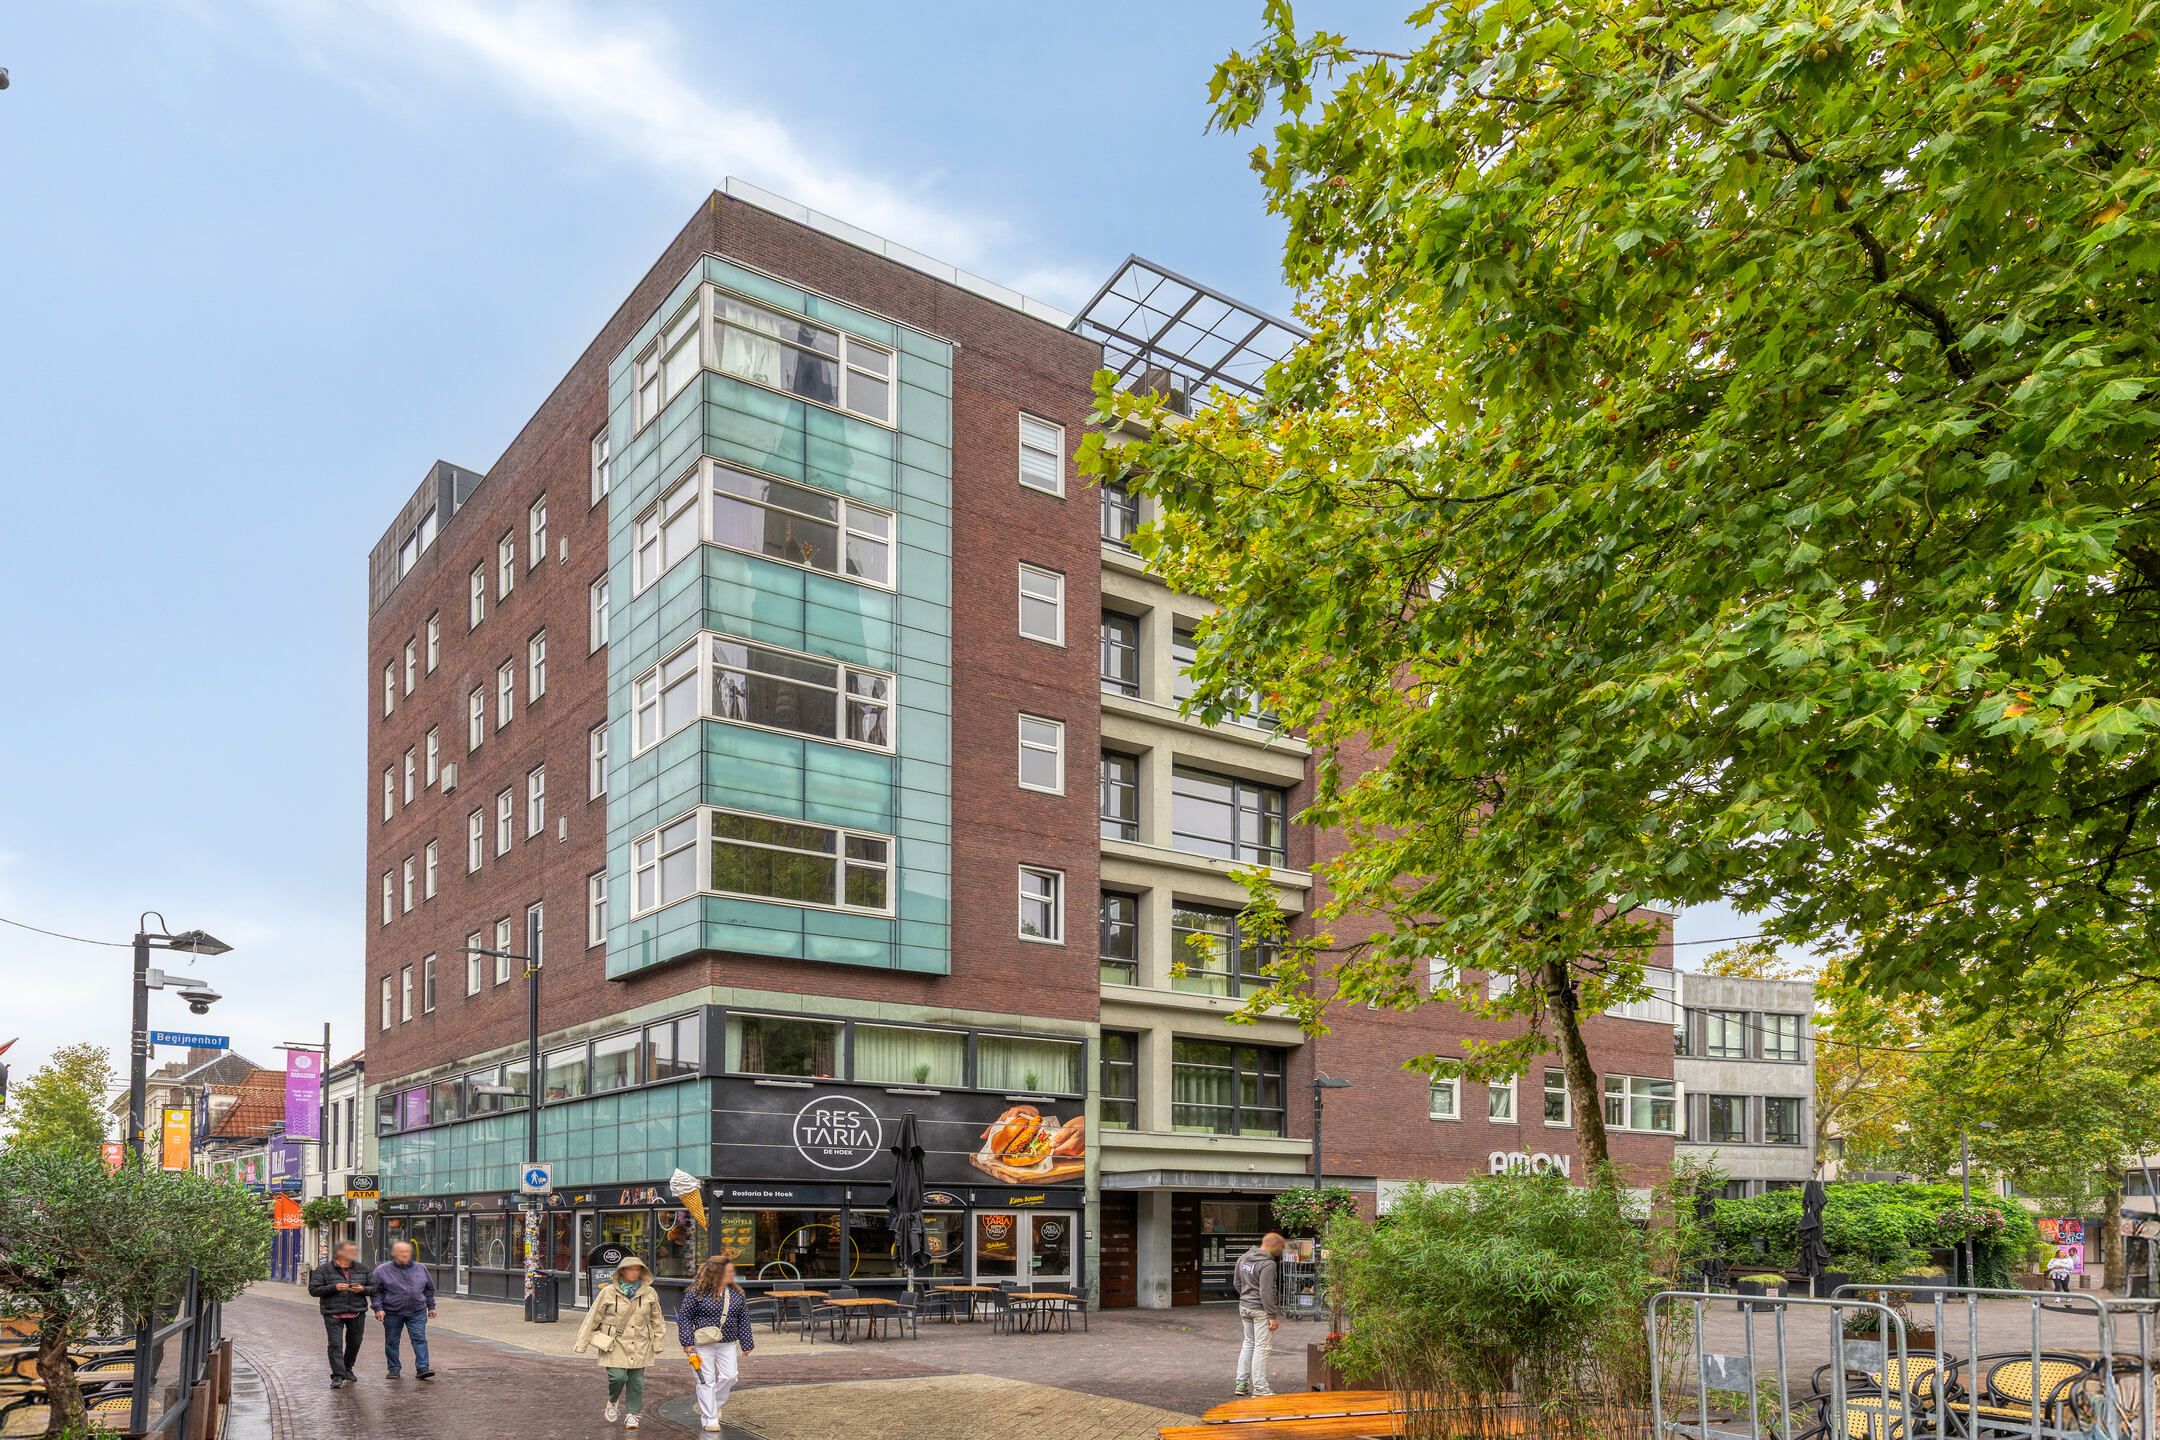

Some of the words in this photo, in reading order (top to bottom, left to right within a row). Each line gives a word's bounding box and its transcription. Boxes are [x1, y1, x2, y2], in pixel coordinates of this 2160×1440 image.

[157, 1033, 223, 1045] Begijnenhof
[816, 1109, 860, 1128] RES
[802, 1127, 873, 1146] TARIA
[1488, 1151, 1570, 1178] AMON
[985, 1217, 1010, 1225] TARIA
